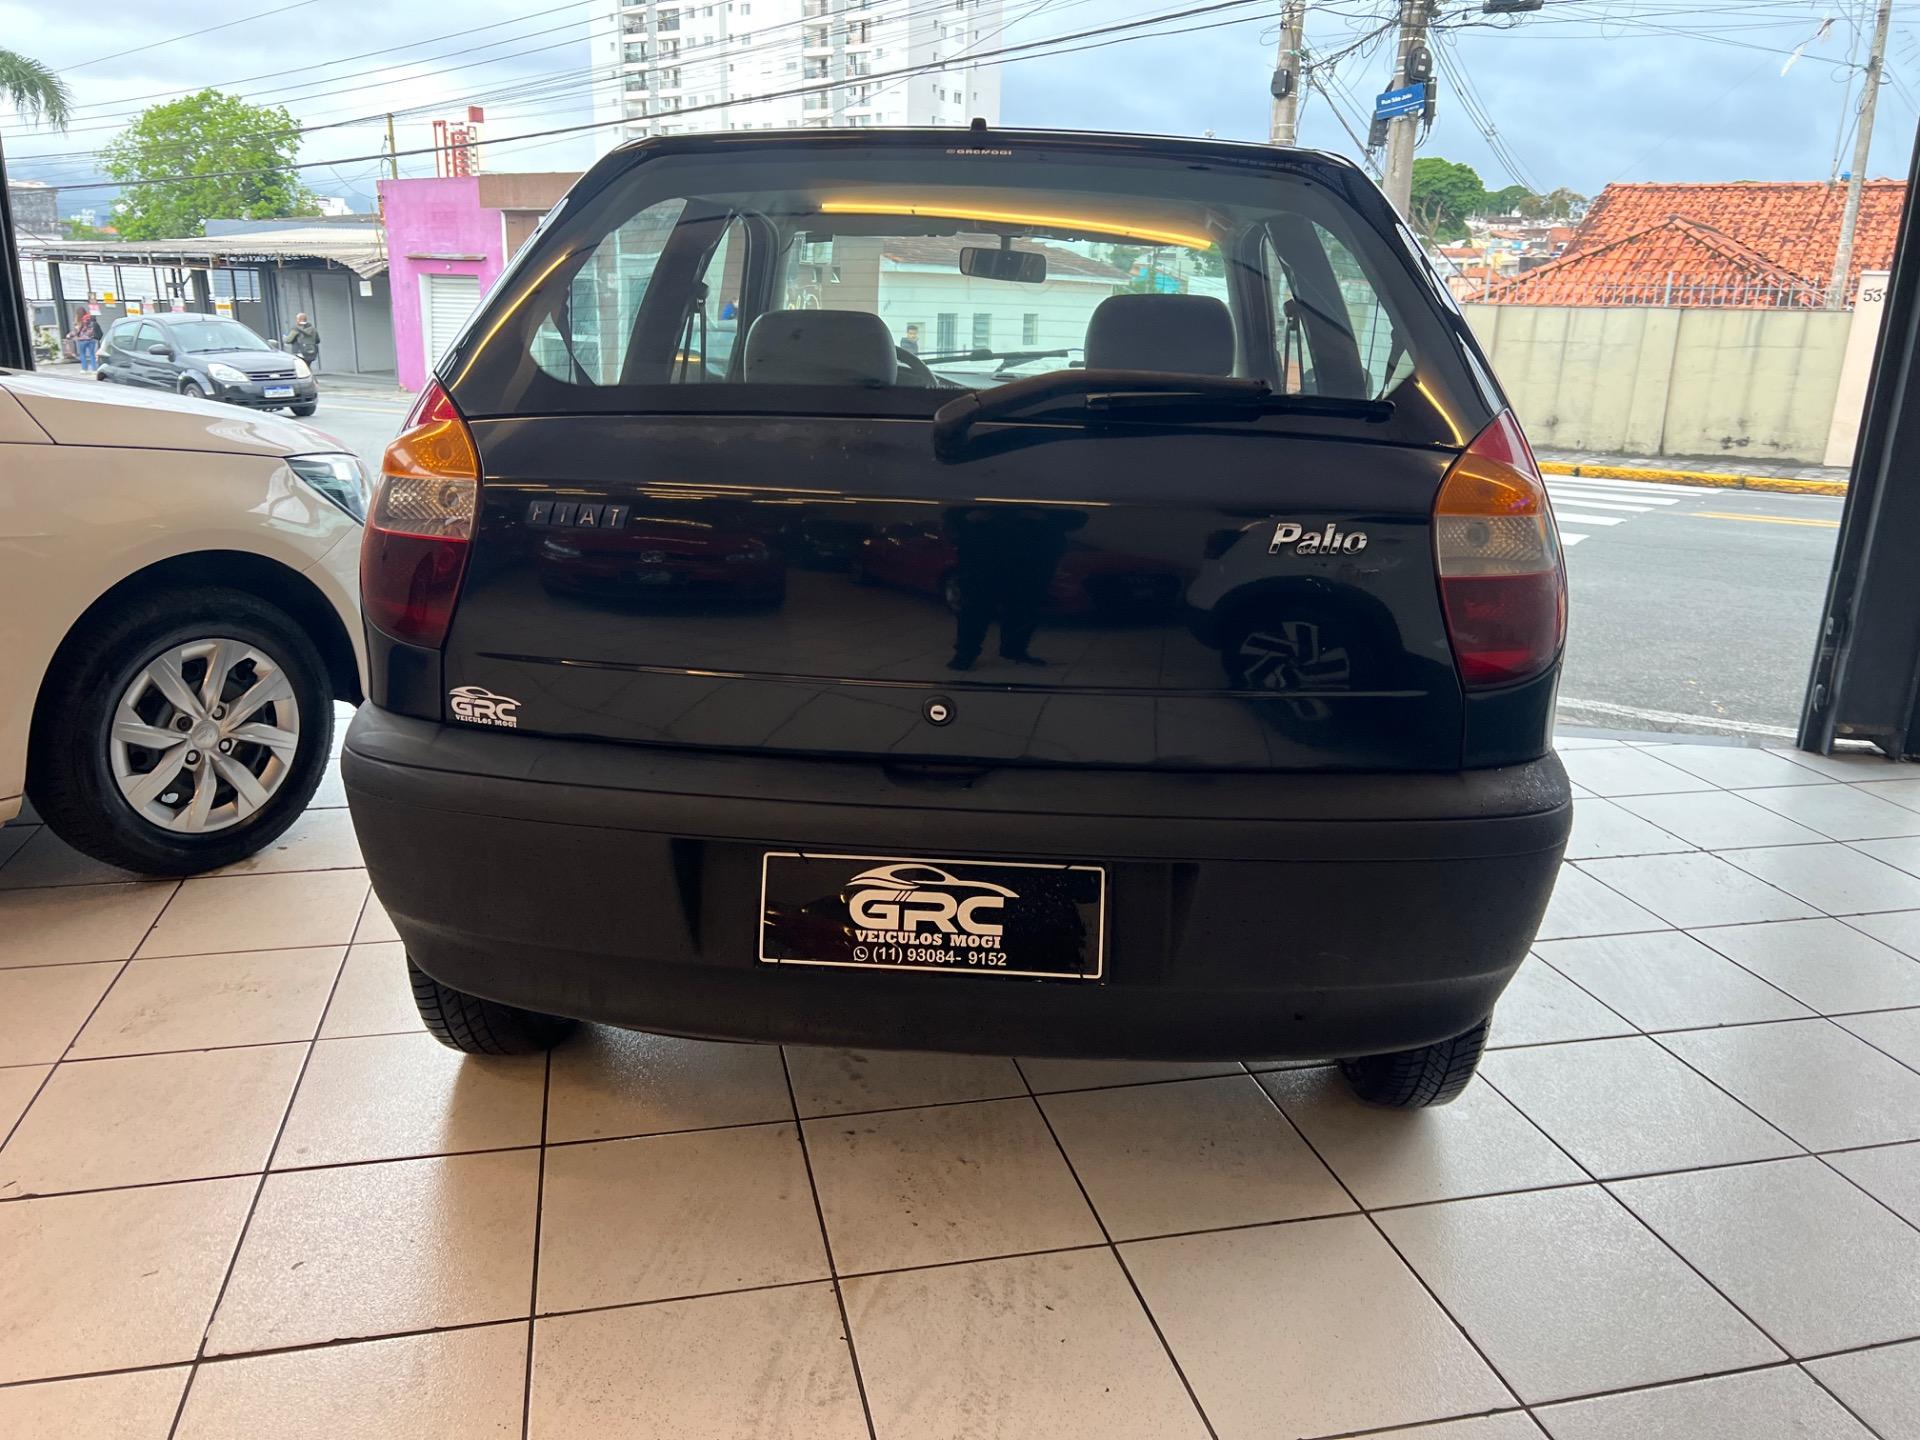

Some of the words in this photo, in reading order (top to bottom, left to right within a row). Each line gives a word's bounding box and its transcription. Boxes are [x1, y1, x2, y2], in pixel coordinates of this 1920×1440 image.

[531, 504, 621, 526] FIAT
[1268, 523, 1368, 554] Palio
[451, 696, 517, 722] GRC
[455, 714, 493, 725] VEICULOS
[494, 719, 517, 728] MOGI
[849, 889, 1005, 936] GRC
[855, 930, 943, 946] VEICULOS
[950, 934, 1002, 949] MOGI
[873, 946, 903, 964] (11)
[907, 948, 962, 963] 93084-
[968, 951, 1007, 966] 9152
